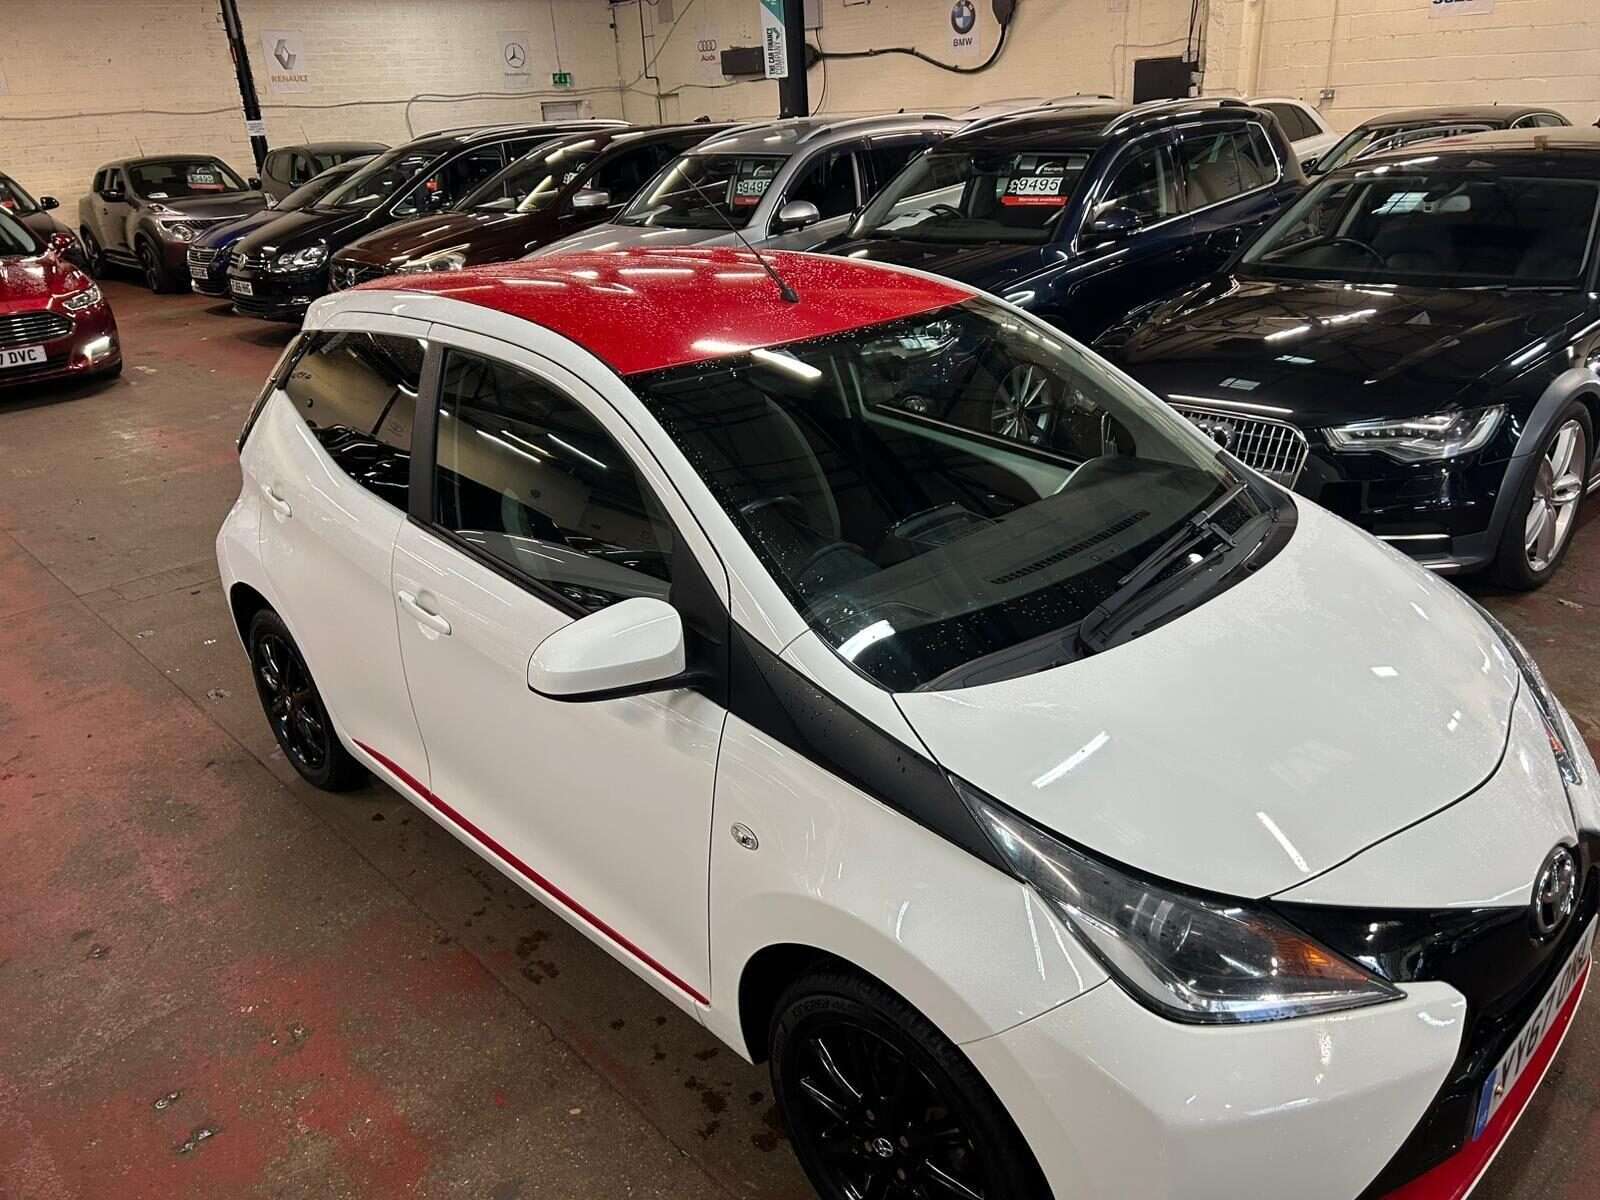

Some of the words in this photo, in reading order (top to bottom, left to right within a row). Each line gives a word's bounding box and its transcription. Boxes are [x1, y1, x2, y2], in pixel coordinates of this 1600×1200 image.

[953, 38, 973, 47] BMW
[701, 53, 716, 61] Audi
[775, 42, 784, 75] COMPANY
[1007, 178, 1060, 193] £9495
[9, 349, 37, 363] DVC
